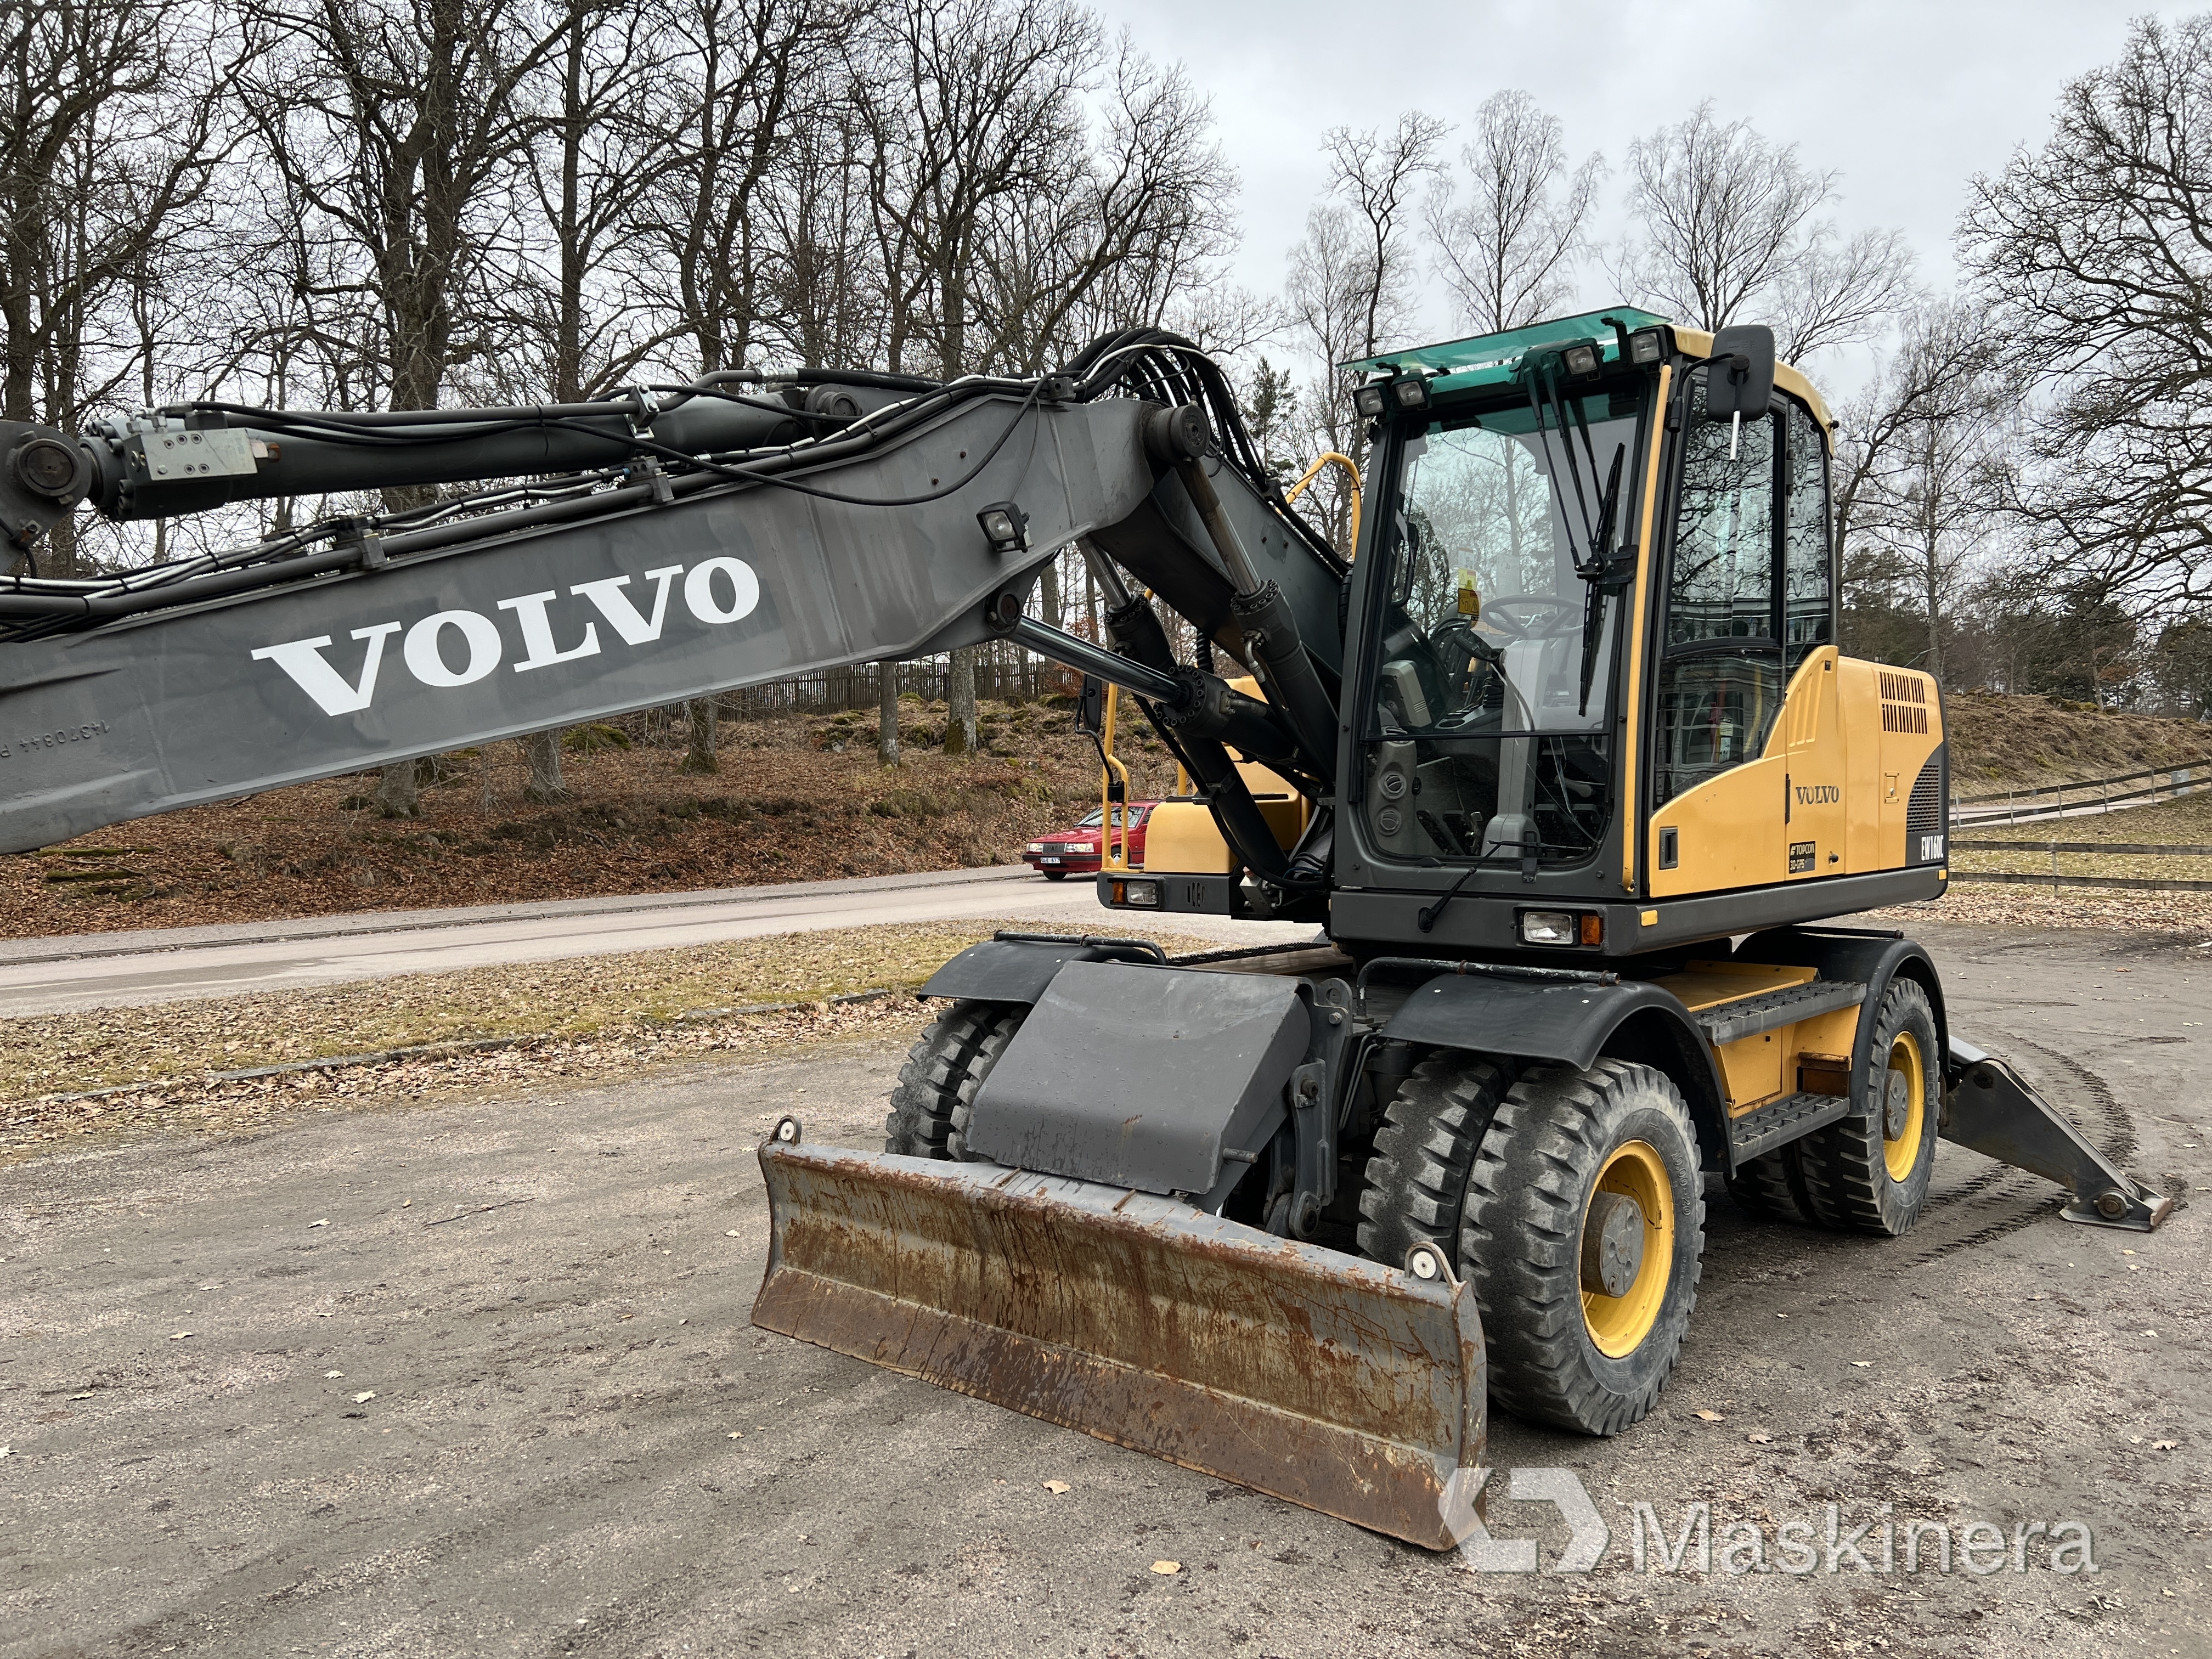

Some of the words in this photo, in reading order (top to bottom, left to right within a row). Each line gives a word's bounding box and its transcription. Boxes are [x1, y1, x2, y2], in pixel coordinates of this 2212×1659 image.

[251, 556, 760, 716] VOLVO
[1796, 786, 1839, 804] VOLVO
[1796, 843, 1815, 855] TOPCON
[1921, 834, 1944, 861] EW160C
[1926, 1069, 1936, 1105] BKT
